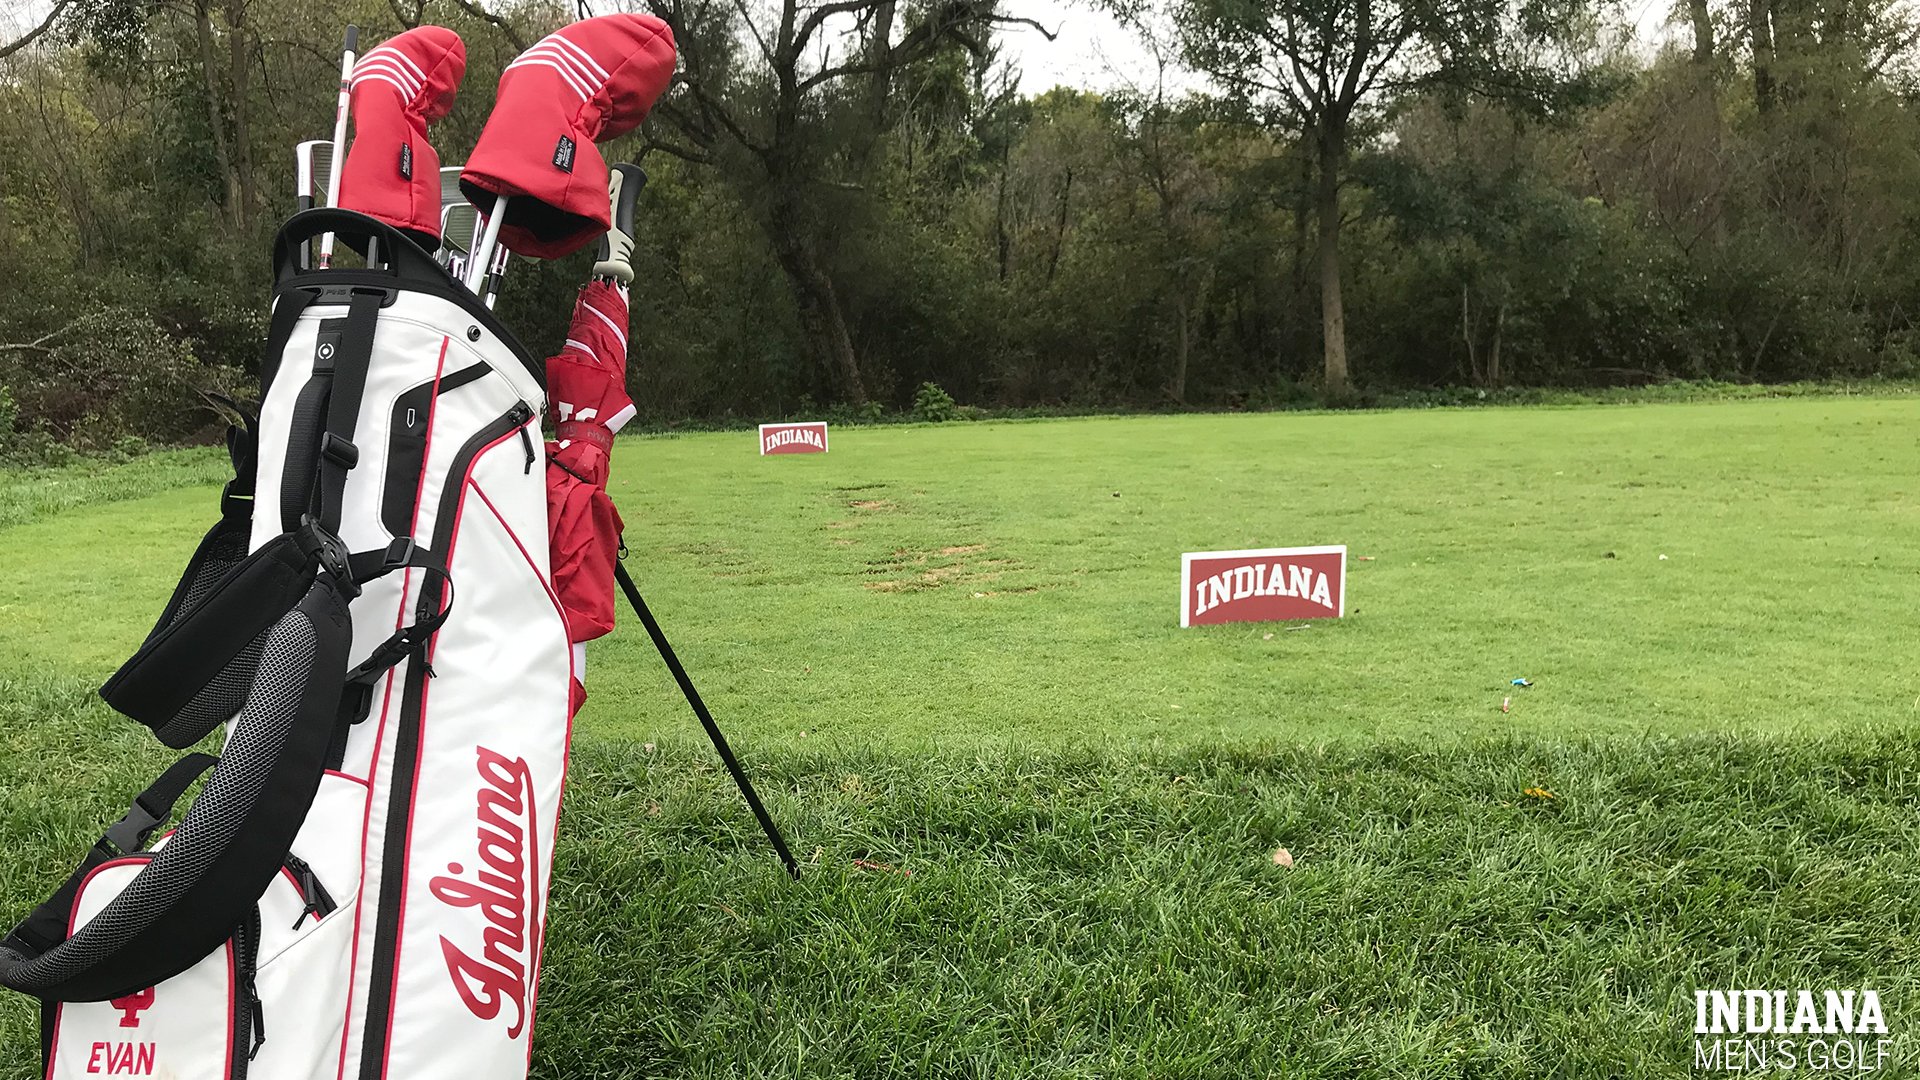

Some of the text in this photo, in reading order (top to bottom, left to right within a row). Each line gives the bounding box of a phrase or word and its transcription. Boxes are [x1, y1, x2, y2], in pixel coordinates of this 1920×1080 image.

[765, 428, 824, 452] INDIANA
[1195, 563, 1334, 616] INDIANA
[429, 745, 539, 1039] Indiana
[87, 1042, 156, 1075] EVAN
